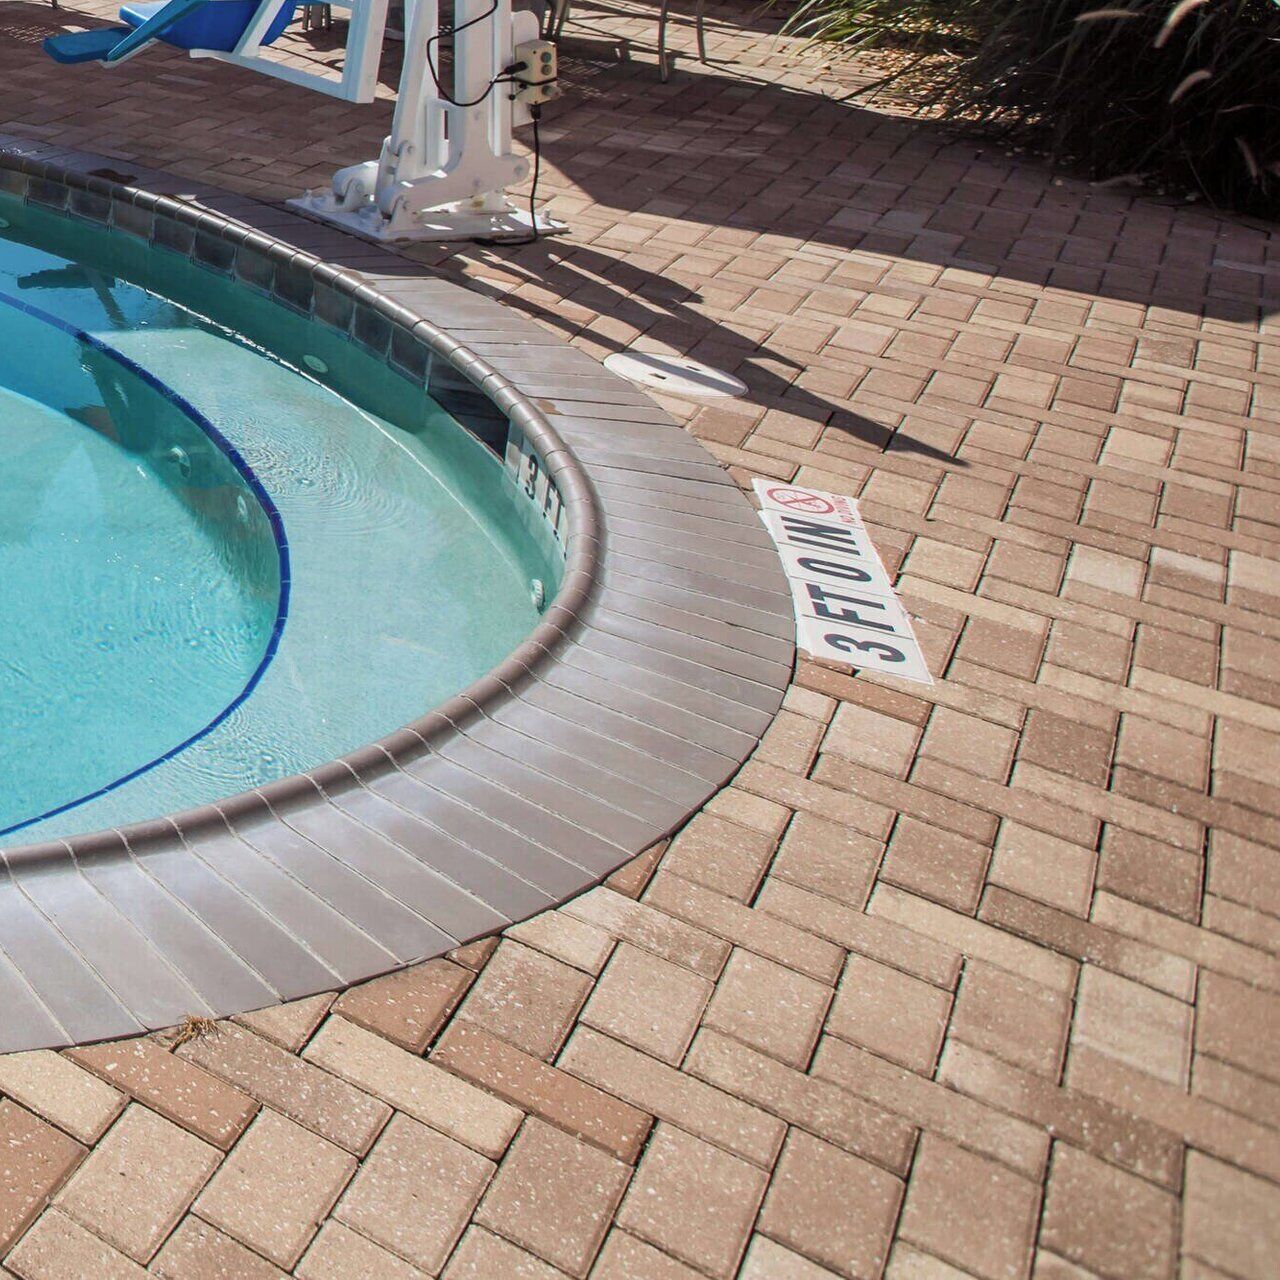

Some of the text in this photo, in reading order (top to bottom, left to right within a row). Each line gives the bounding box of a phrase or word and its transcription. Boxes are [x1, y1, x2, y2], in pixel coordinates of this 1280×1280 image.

[525, 455, 538, 500] 3
[780, 515, 861, 556] IN
[805, 583, 895, 632] FT
[824, 633, 906, 663] 3
